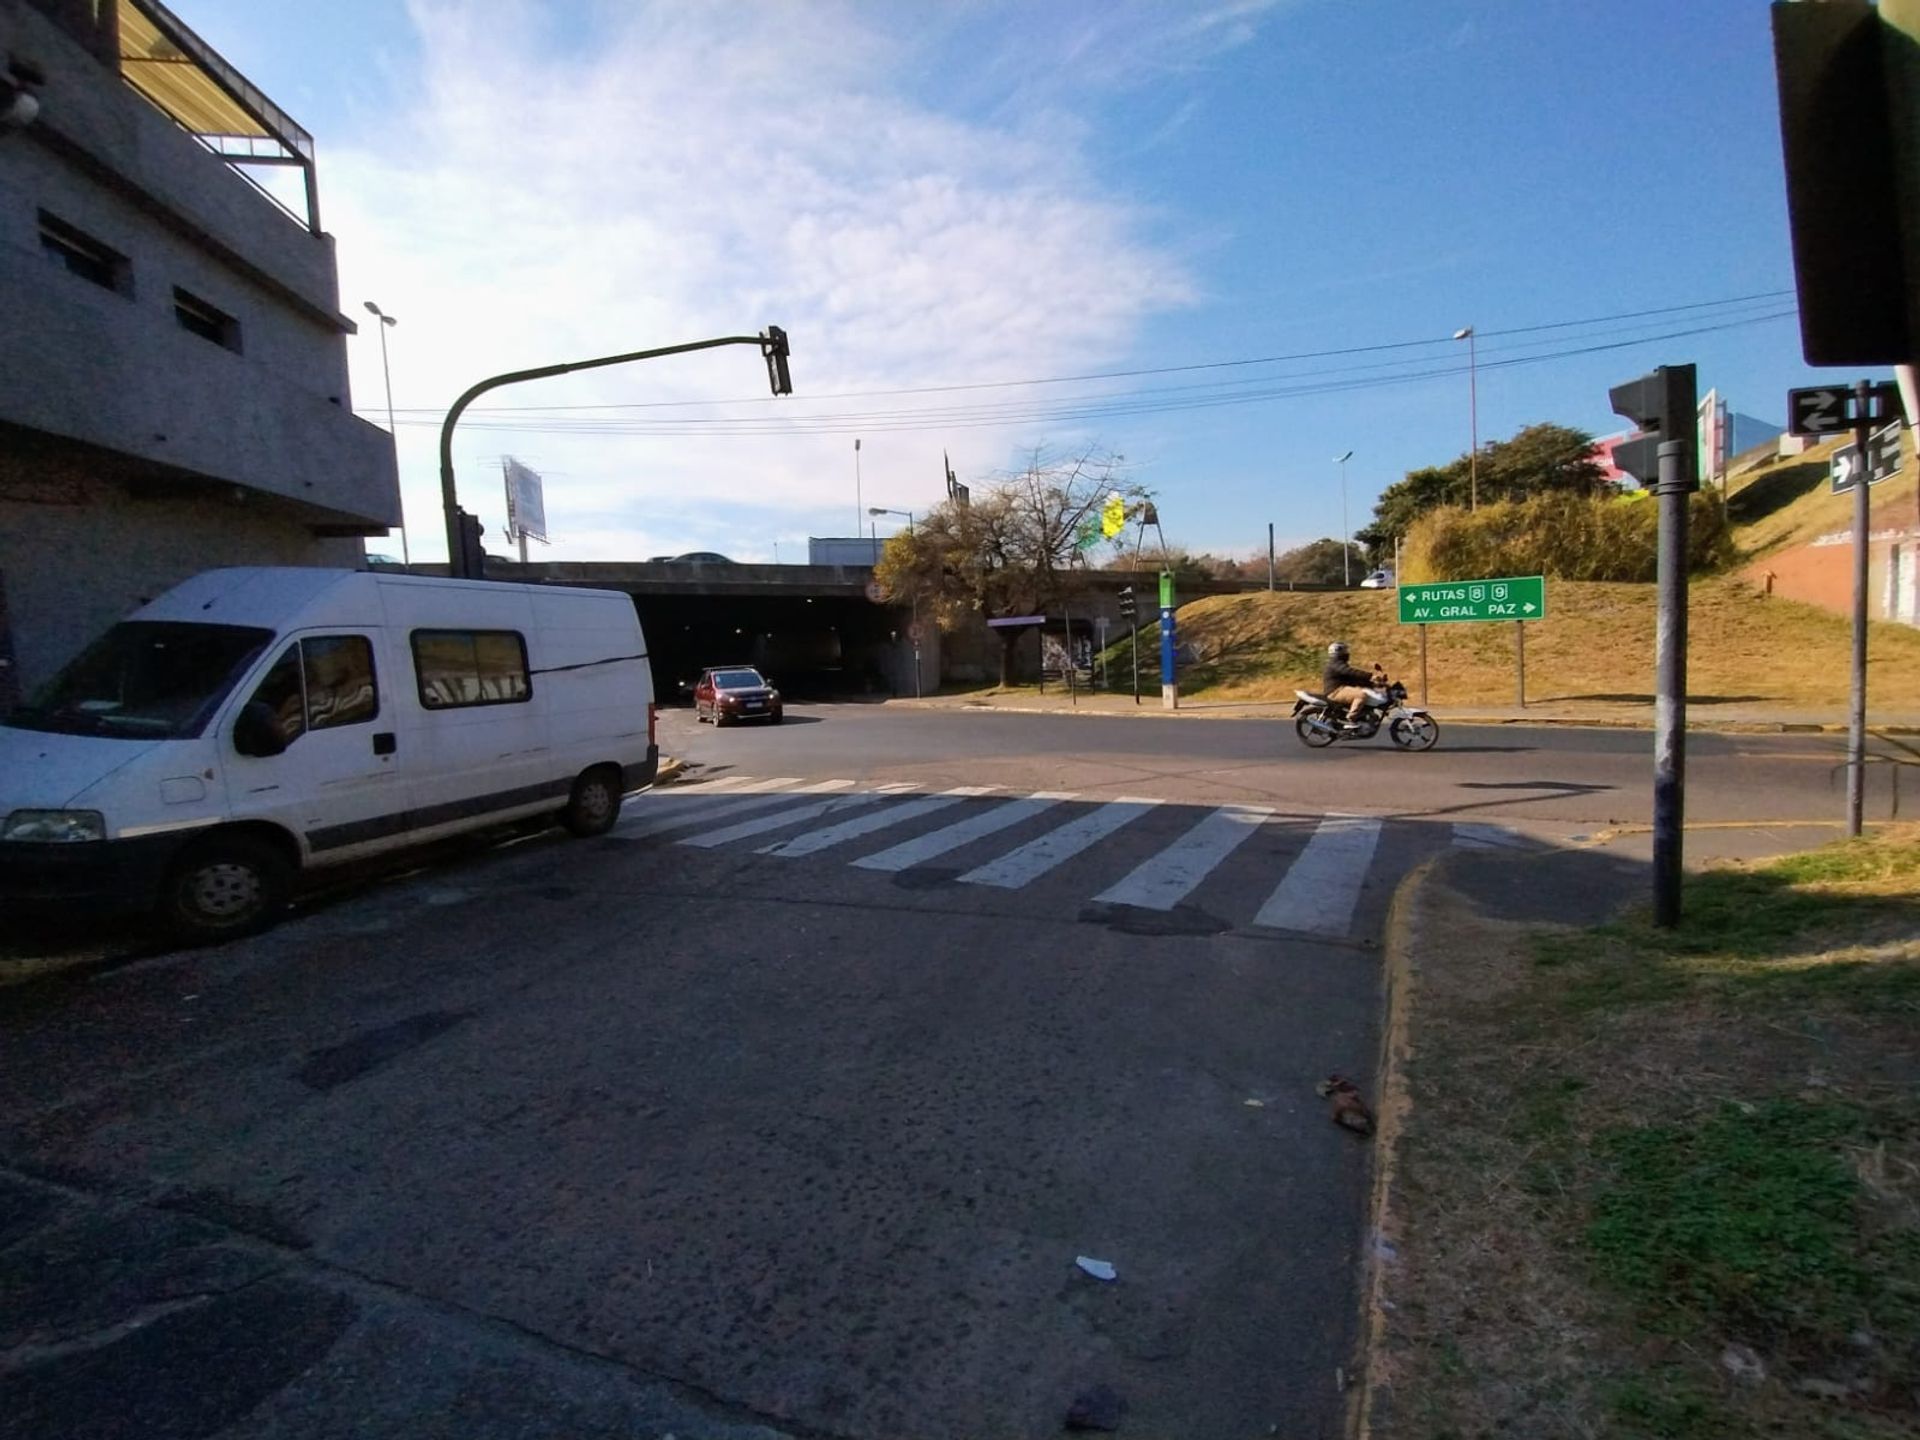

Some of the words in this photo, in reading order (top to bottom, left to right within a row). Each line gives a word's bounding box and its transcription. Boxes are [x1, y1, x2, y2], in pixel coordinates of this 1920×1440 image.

[1421, 589, 1465, 602] RUTAS
[1472, 588, 1481, 599] 8
[1495, 587, 1504, 598] 9
[1440, 605, 1477, 617] GRAL
[1488, 603, 1516, 615] PAZ
